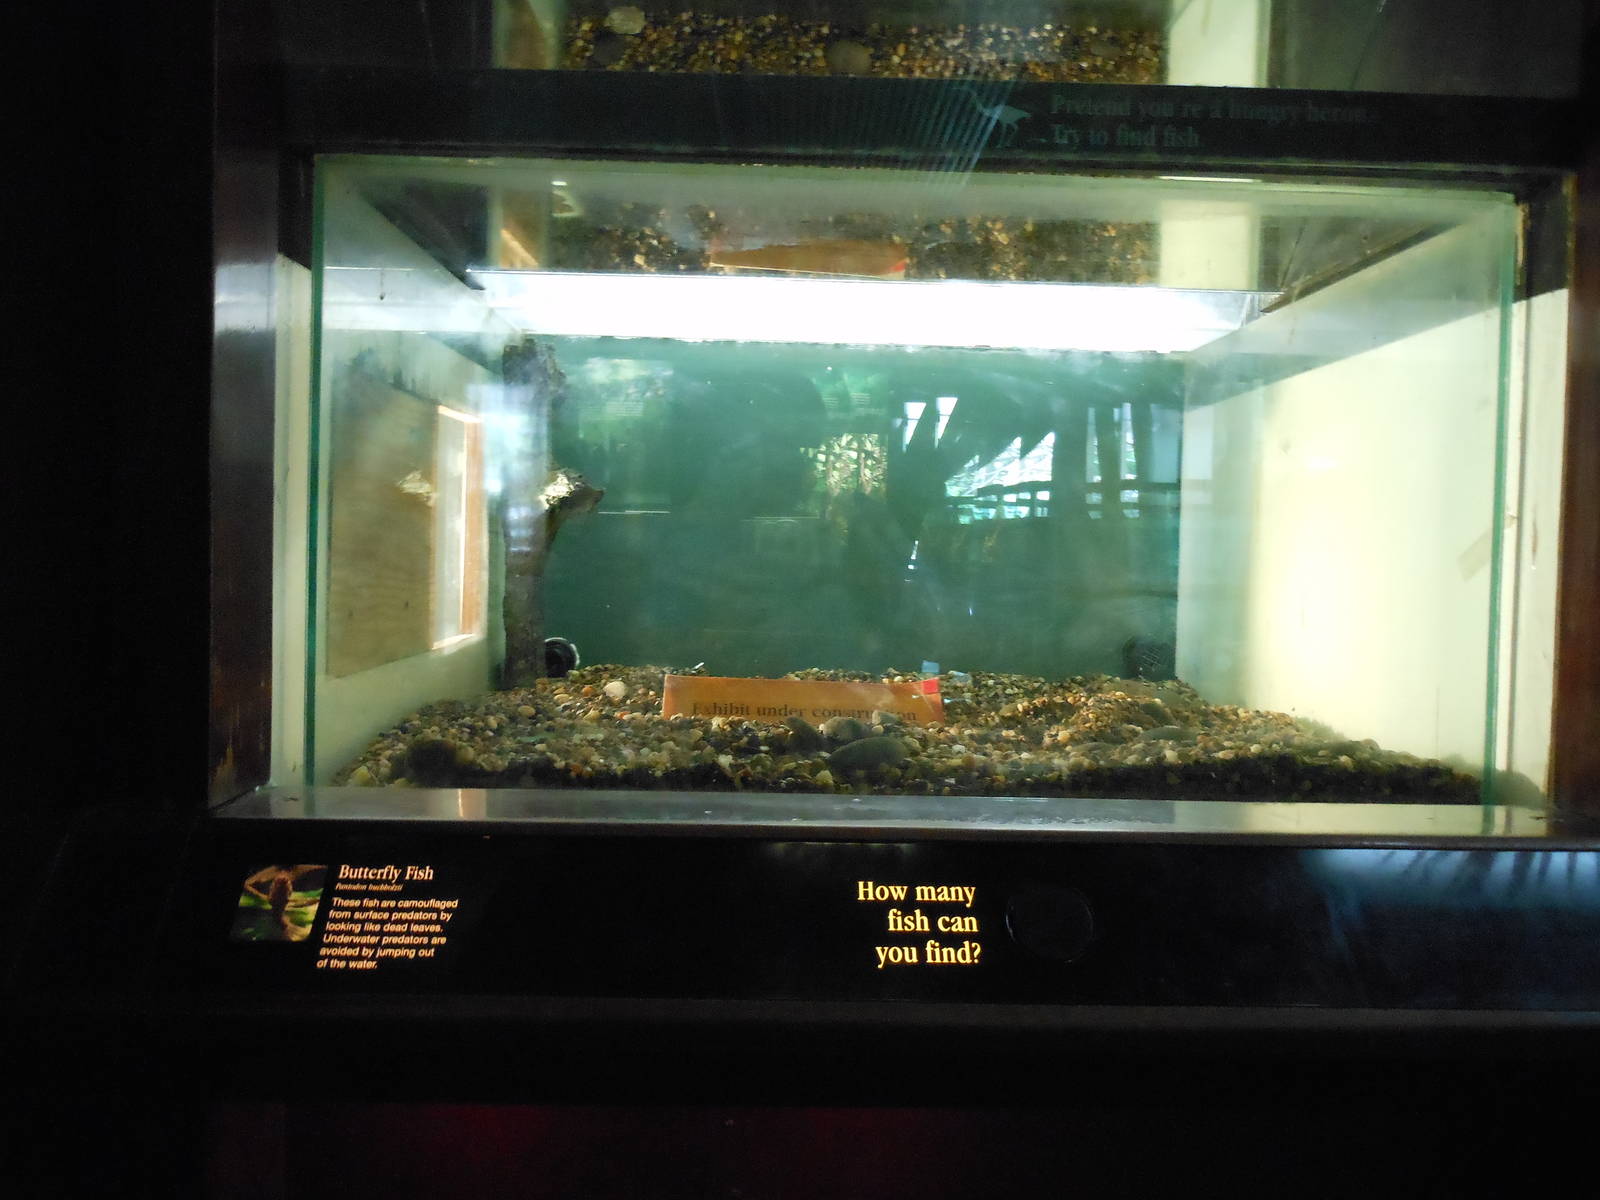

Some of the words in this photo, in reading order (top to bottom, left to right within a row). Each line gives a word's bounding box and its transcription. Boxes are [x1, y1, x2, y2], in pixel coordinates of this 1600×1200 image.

[1050, 94, 1131, 116] Pretend
[1209, 106, 1222, 118] a
[1088, 128, 1108, 146] to
[1116, 123, 1156, 146] find
[1162, 124, 1199, 147] fish
[691, 702, 750, 716] Exhibit
[755, 704, 807, 718] under
[338, 864, 401, 884] Butterfly
[404, 866, 434, 881] Fish
[857, 881, 908, 901] How
[915, 885, 976, 908] many
[332, 897, 361, 907] These
[362, 898, 379, 908] fish
[380, 900, 396, 909] are
[397, 898, 459, 910] camouflaged
[329, 909, 351, 919] from
[353, 910, 390, 920] surface
[391, 911, 437, 921] predators
[439, 911, 453, 922] by
[888, 908, 930, 932] fish
[937, 915, 979, 932] can
[325, 921, 361, 932] looking
[363, 922, 381, 932] like
[383, 923, 408, 933] dead
[410, 923, 444, 933] leaves.
[322, 933, 380, 944] Underwater
[381, 935, 429, 946] predators
[430, 936, 447, 944] are
[319, 946, 360, 957] avoided
[361, 947, 375, 959] by
[375, 947, 417, 959] jumping
[418, 949, 435, 957] out
[875, 945, 919, 969] you
[925, 939, 981, 964] find?
[316, 958, 329, 969] of
[329, 958, 347, 969] the
[349, 960, 378, 969] water.
